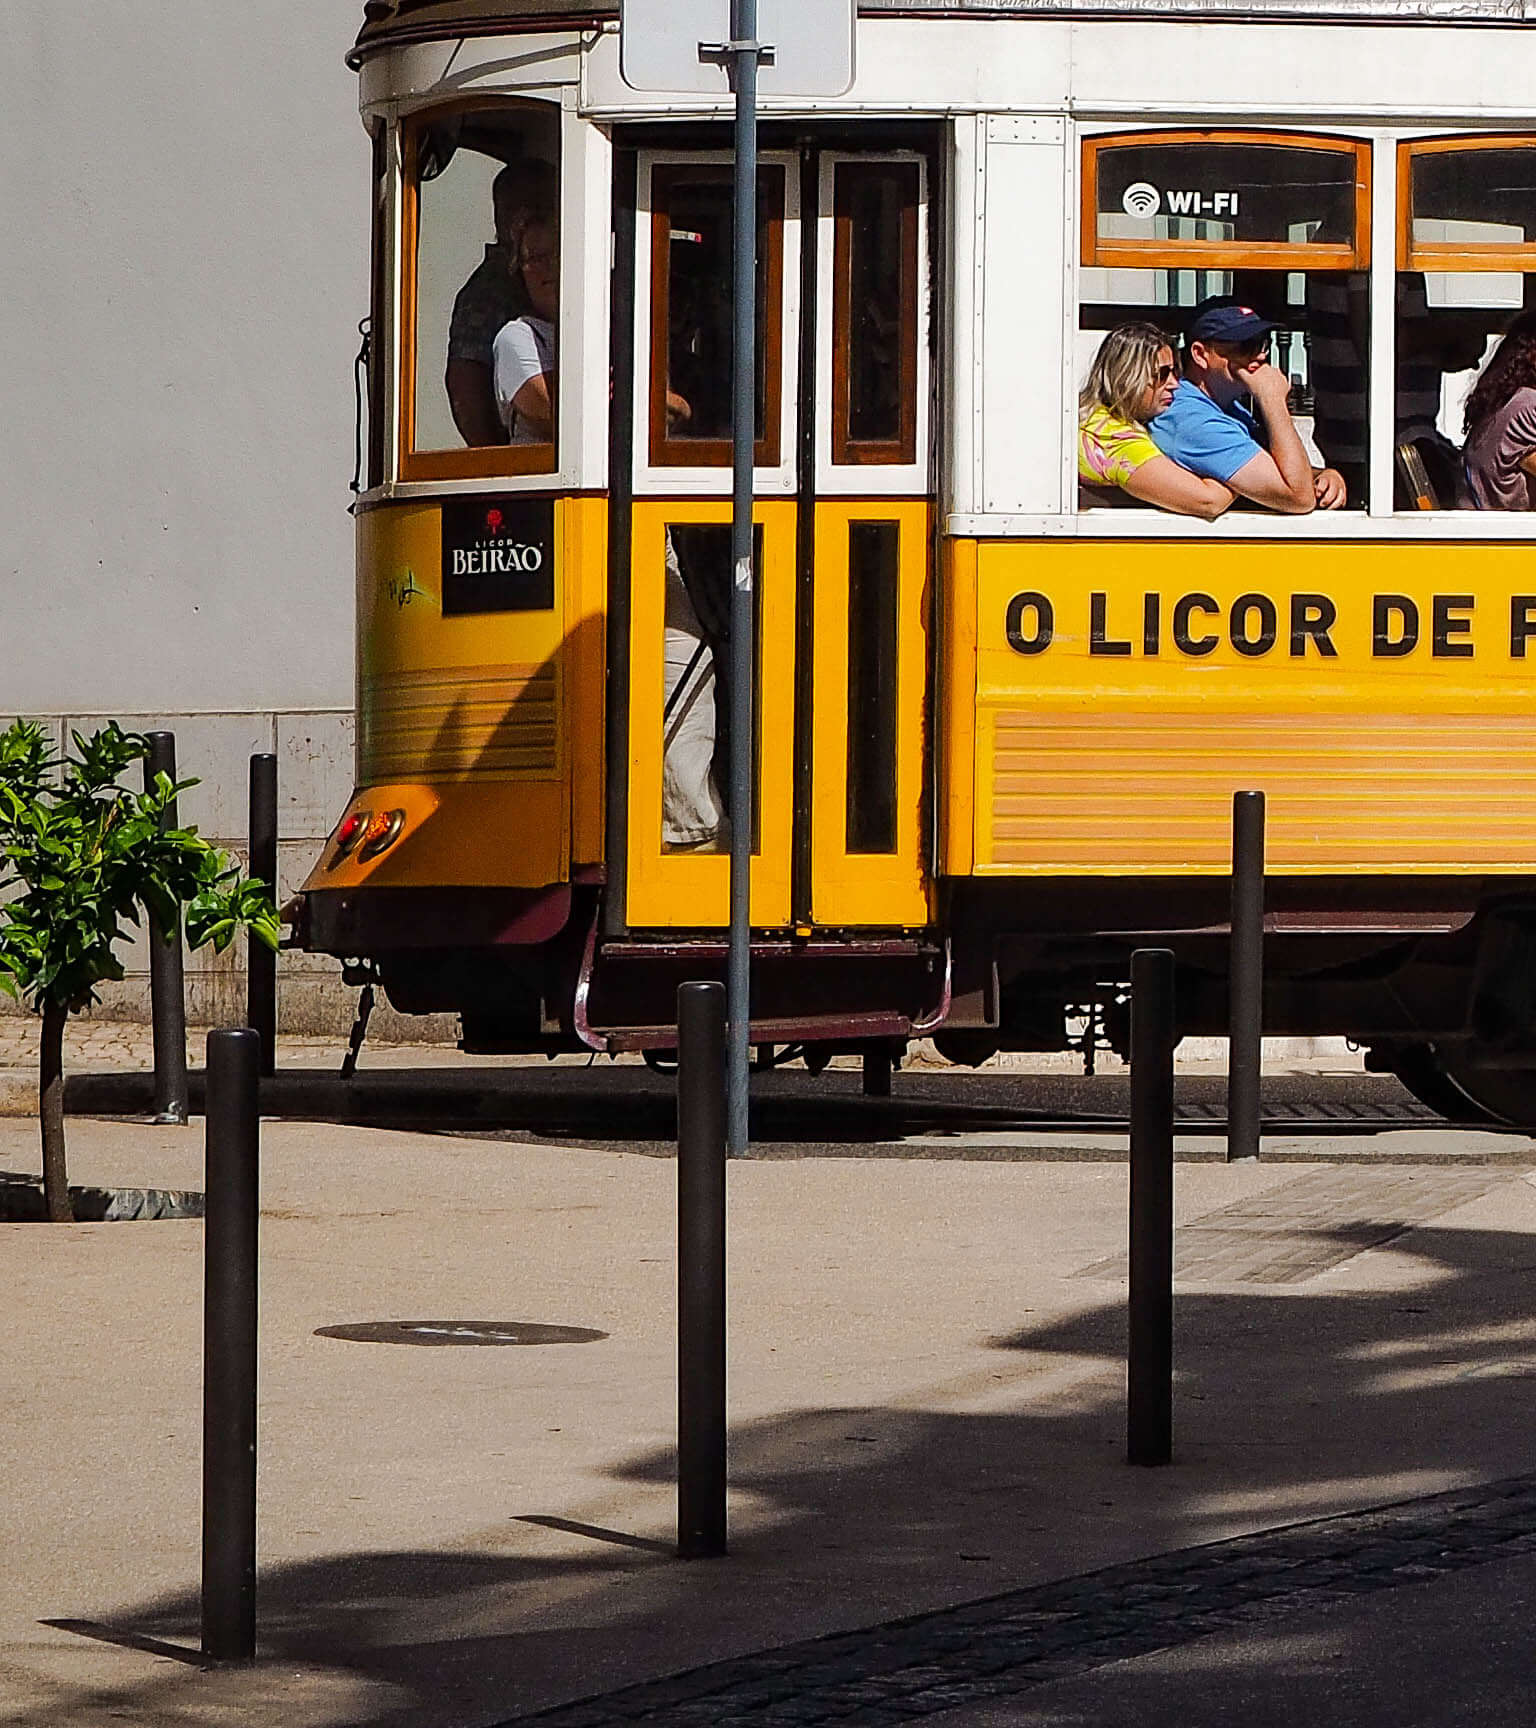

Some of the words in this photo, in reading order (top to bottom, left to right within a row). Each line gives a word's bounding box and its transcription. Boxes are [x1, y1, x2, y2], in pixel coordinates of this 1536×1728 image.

[1166, 190, 1238, 215] WI-FI
[475, 538, 513, 549] LICOR
[452, 543, 542, 575] BEIRÃO
[1005, 591, 1054, 656] O
[1088, 592, 1338, 658] LICOR
[1372, 594, 1475, 658] DE
